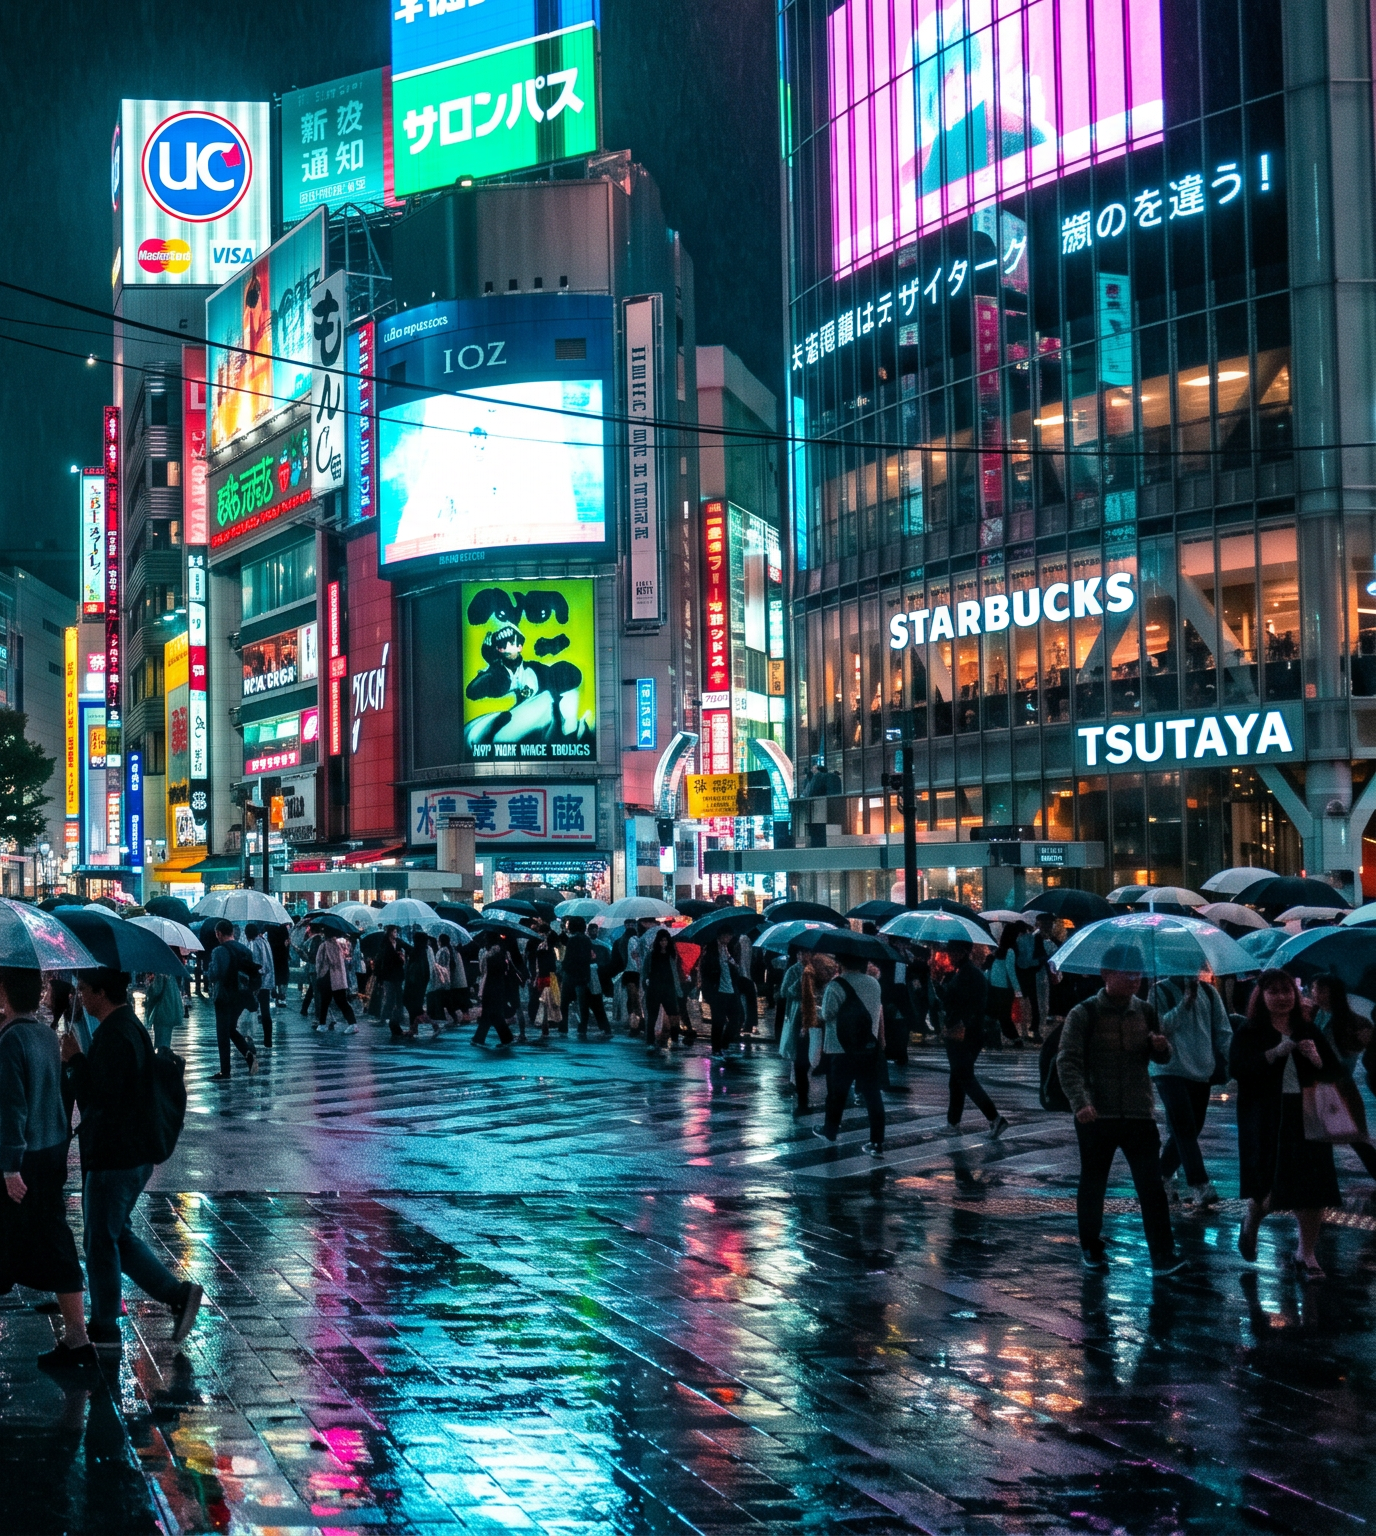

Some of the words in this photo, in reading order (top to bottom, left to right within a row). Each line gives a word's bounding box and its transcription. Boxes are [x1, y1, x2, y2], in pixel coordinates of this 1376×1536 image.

[403, 67, 585, 155] サロンパス
[301, 139, 364, 182] 通知
[213, 247, 254, 264] VISA
[888, 571, 1136, 651] STARBUCKS
[1078, 710, 1294, 767] TSUTAYA
